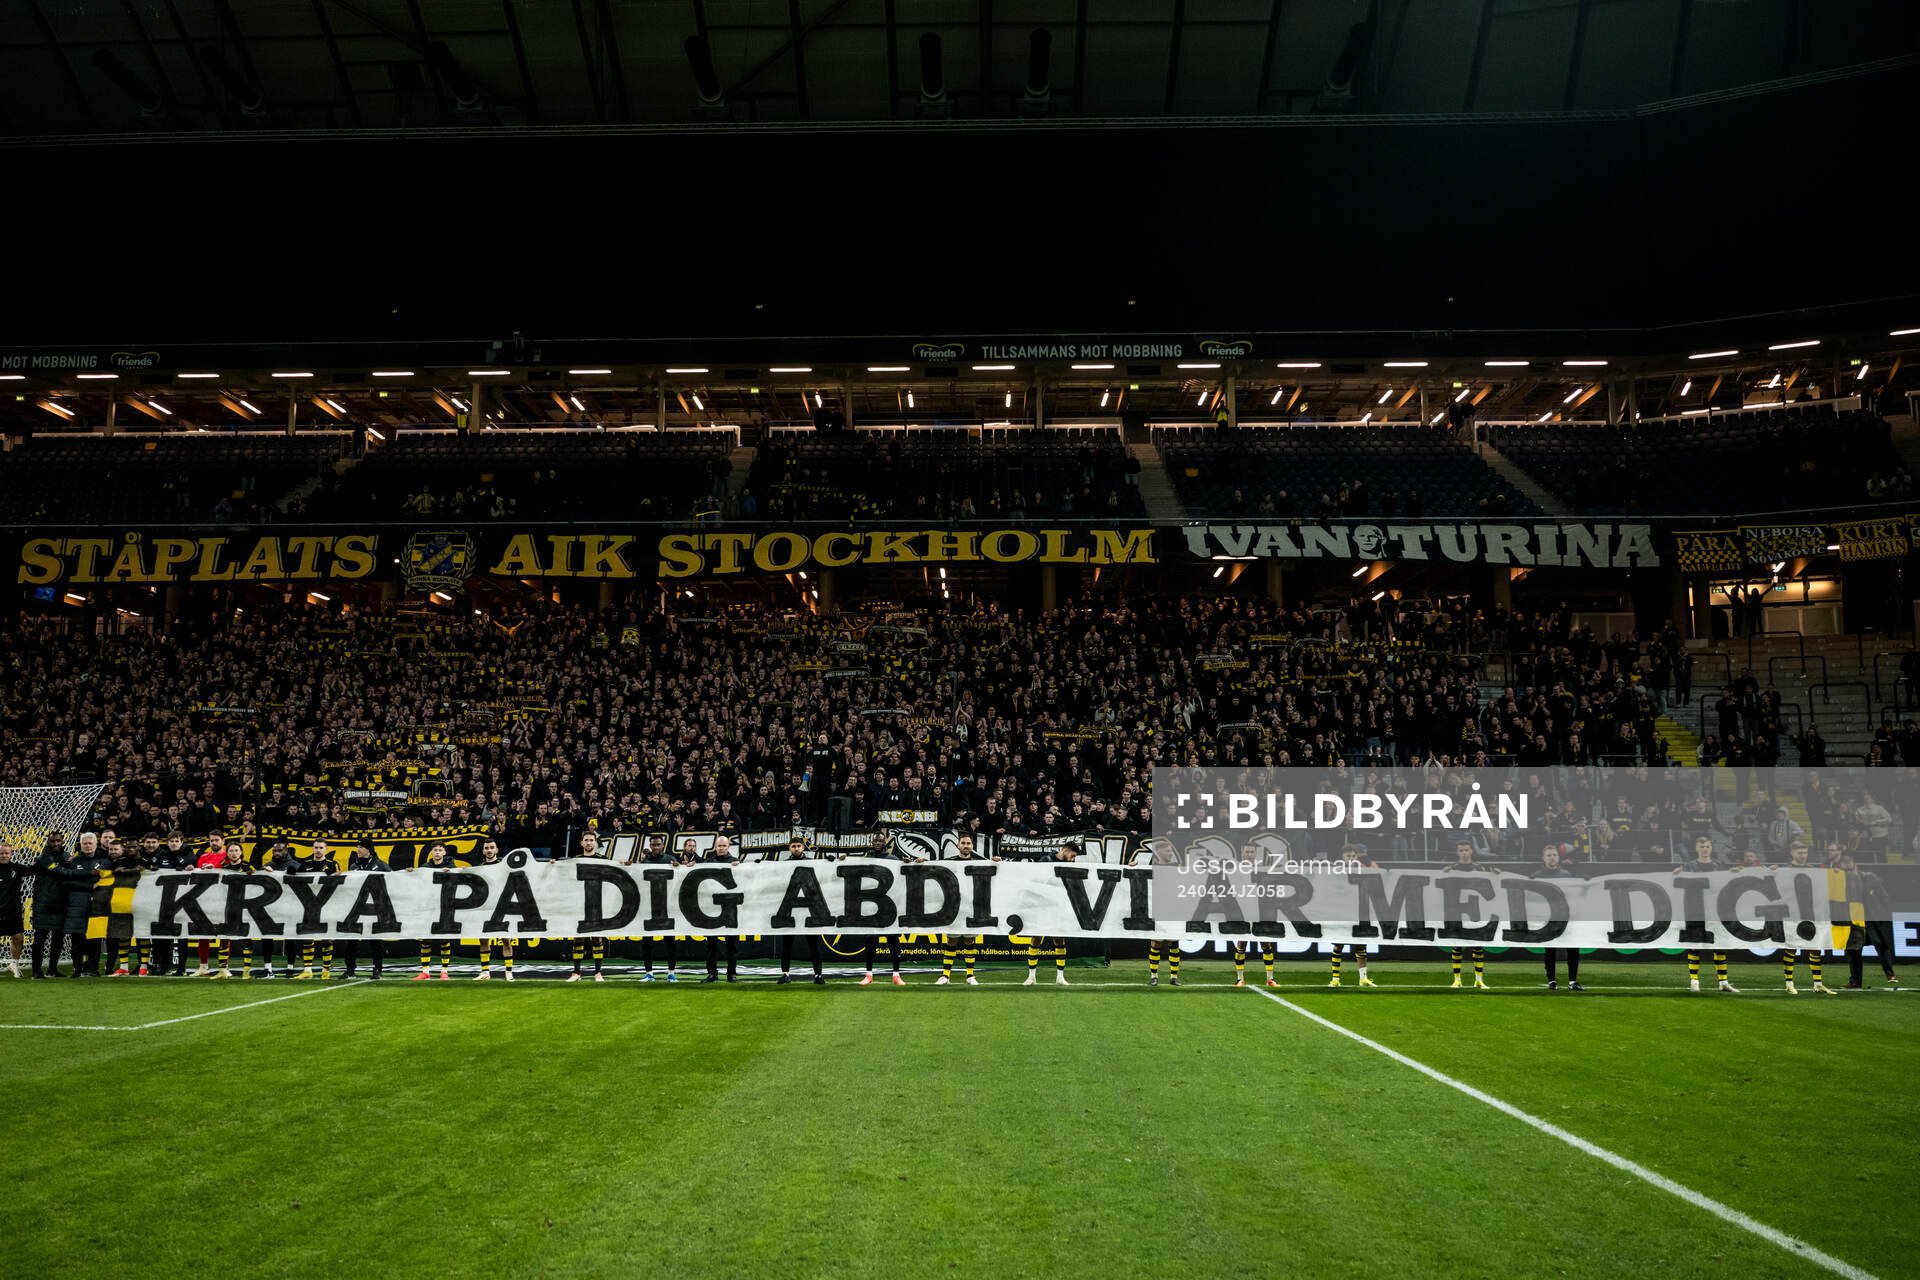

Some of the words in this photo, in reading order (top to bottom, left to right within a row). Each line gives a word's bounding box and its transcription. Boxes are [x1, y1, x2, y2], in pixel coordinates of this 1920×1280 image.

[117, 355, 152, 366] friends
[920, 347, 957, 358] friends
[981, 345, 1078, 359] TILLSAMMANS
[1080, 345, 1109, 358] MOT
[1112, 344, 1182, 358] MOBBNING
[1206, 345, 1245, 357] friends
[2, 355, 29, 369] MOT
[31, 354, 98, 368] MOBBNING
[1838, 521, 1902, 541] KURT
[1182, 524, 1351, 559] IVAN
[1387, 522, 1660, 568] TURINA
[1675, 533, 1739, 552] PÄRA
[17, 530, 378, 585] STÅPLATS
[489, 533, 638, 579] AIK
[656, 527, 1159, 579] STOCKHOLM
[151, 873, 401, 936] KRYA
[431, 851, 547, 935] PÅ
[577, 863, 744, 934] DIG
[771, 865, 1023, 936] ABDI,
[1054, 866, 1155, 932] VI
[1347, 872, 1570, 942] MED
[1604, 873, 1816, 944] DIG!
